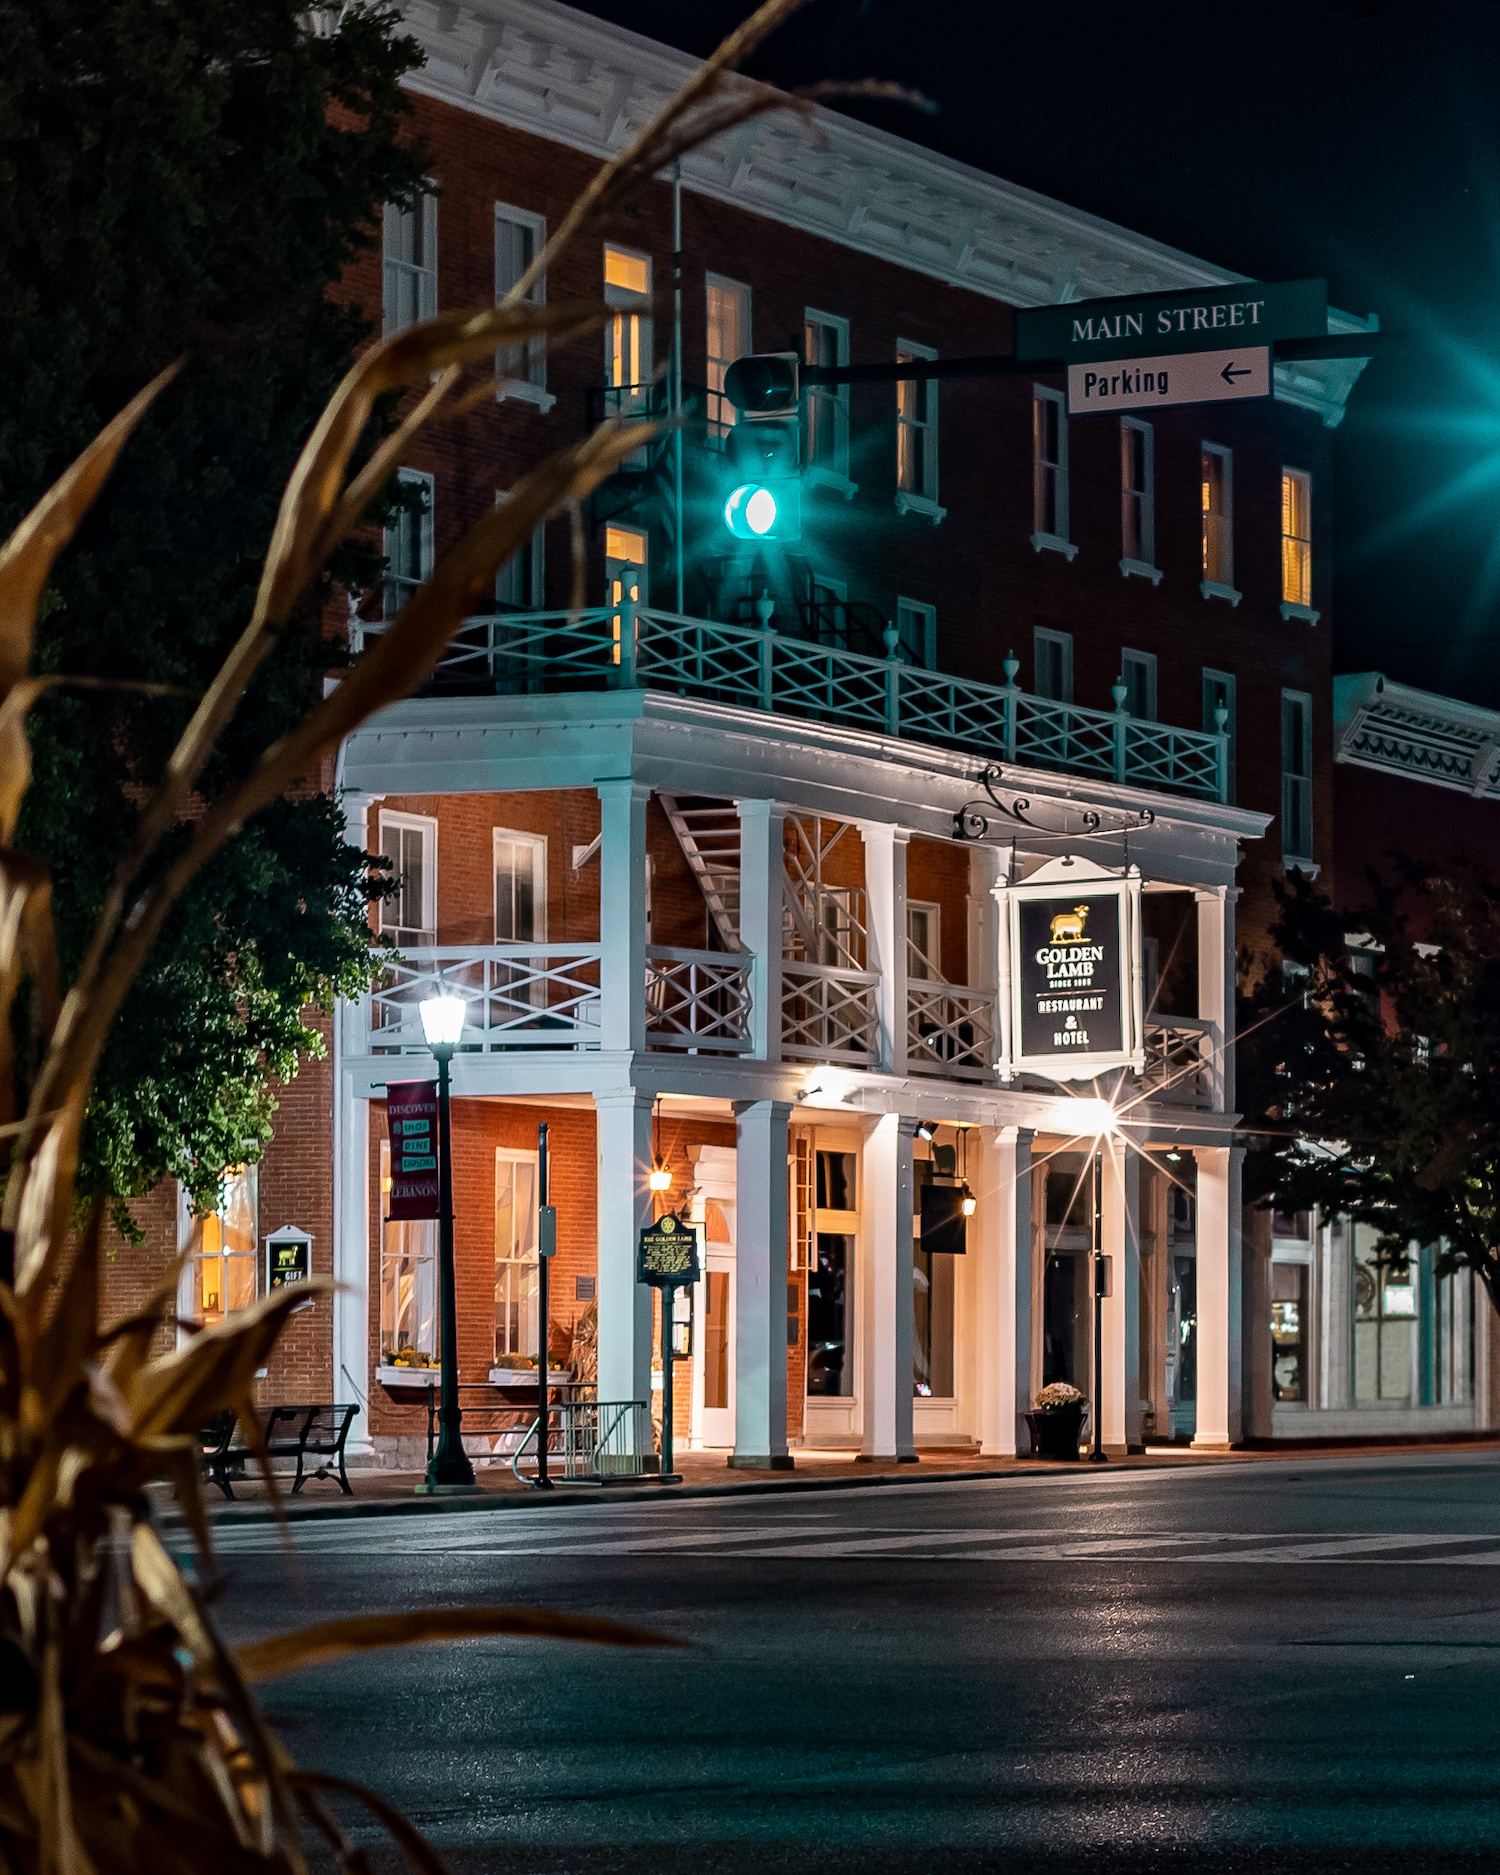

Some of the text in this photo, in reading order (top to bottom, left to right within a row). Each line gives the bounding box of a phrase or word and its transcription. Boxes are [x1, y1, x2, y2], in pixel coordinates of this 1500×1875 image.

[1072, 300, 1265, 342] MAIN STREET
[1085, 368, 1168, 398] Parking
[1036, 946, 1104, 964] GOLDEN
[1046, 962, 1094, 979] LAMB
[1037, 997, 1104, 1014] RESTAURANT
[1064, 1015, 1078, 1030] &
[1053, 1031, 1090, 1046] HOTEL
[389, 1103, 435, 1114] DISCOVER
[404, 1122, 428, 1132] SHOP
[404, 1141, 428, 1150] DINE
[391, 1186, 437, 1197] LEBANON
[285, 1271, 302, 1280] GIFT
